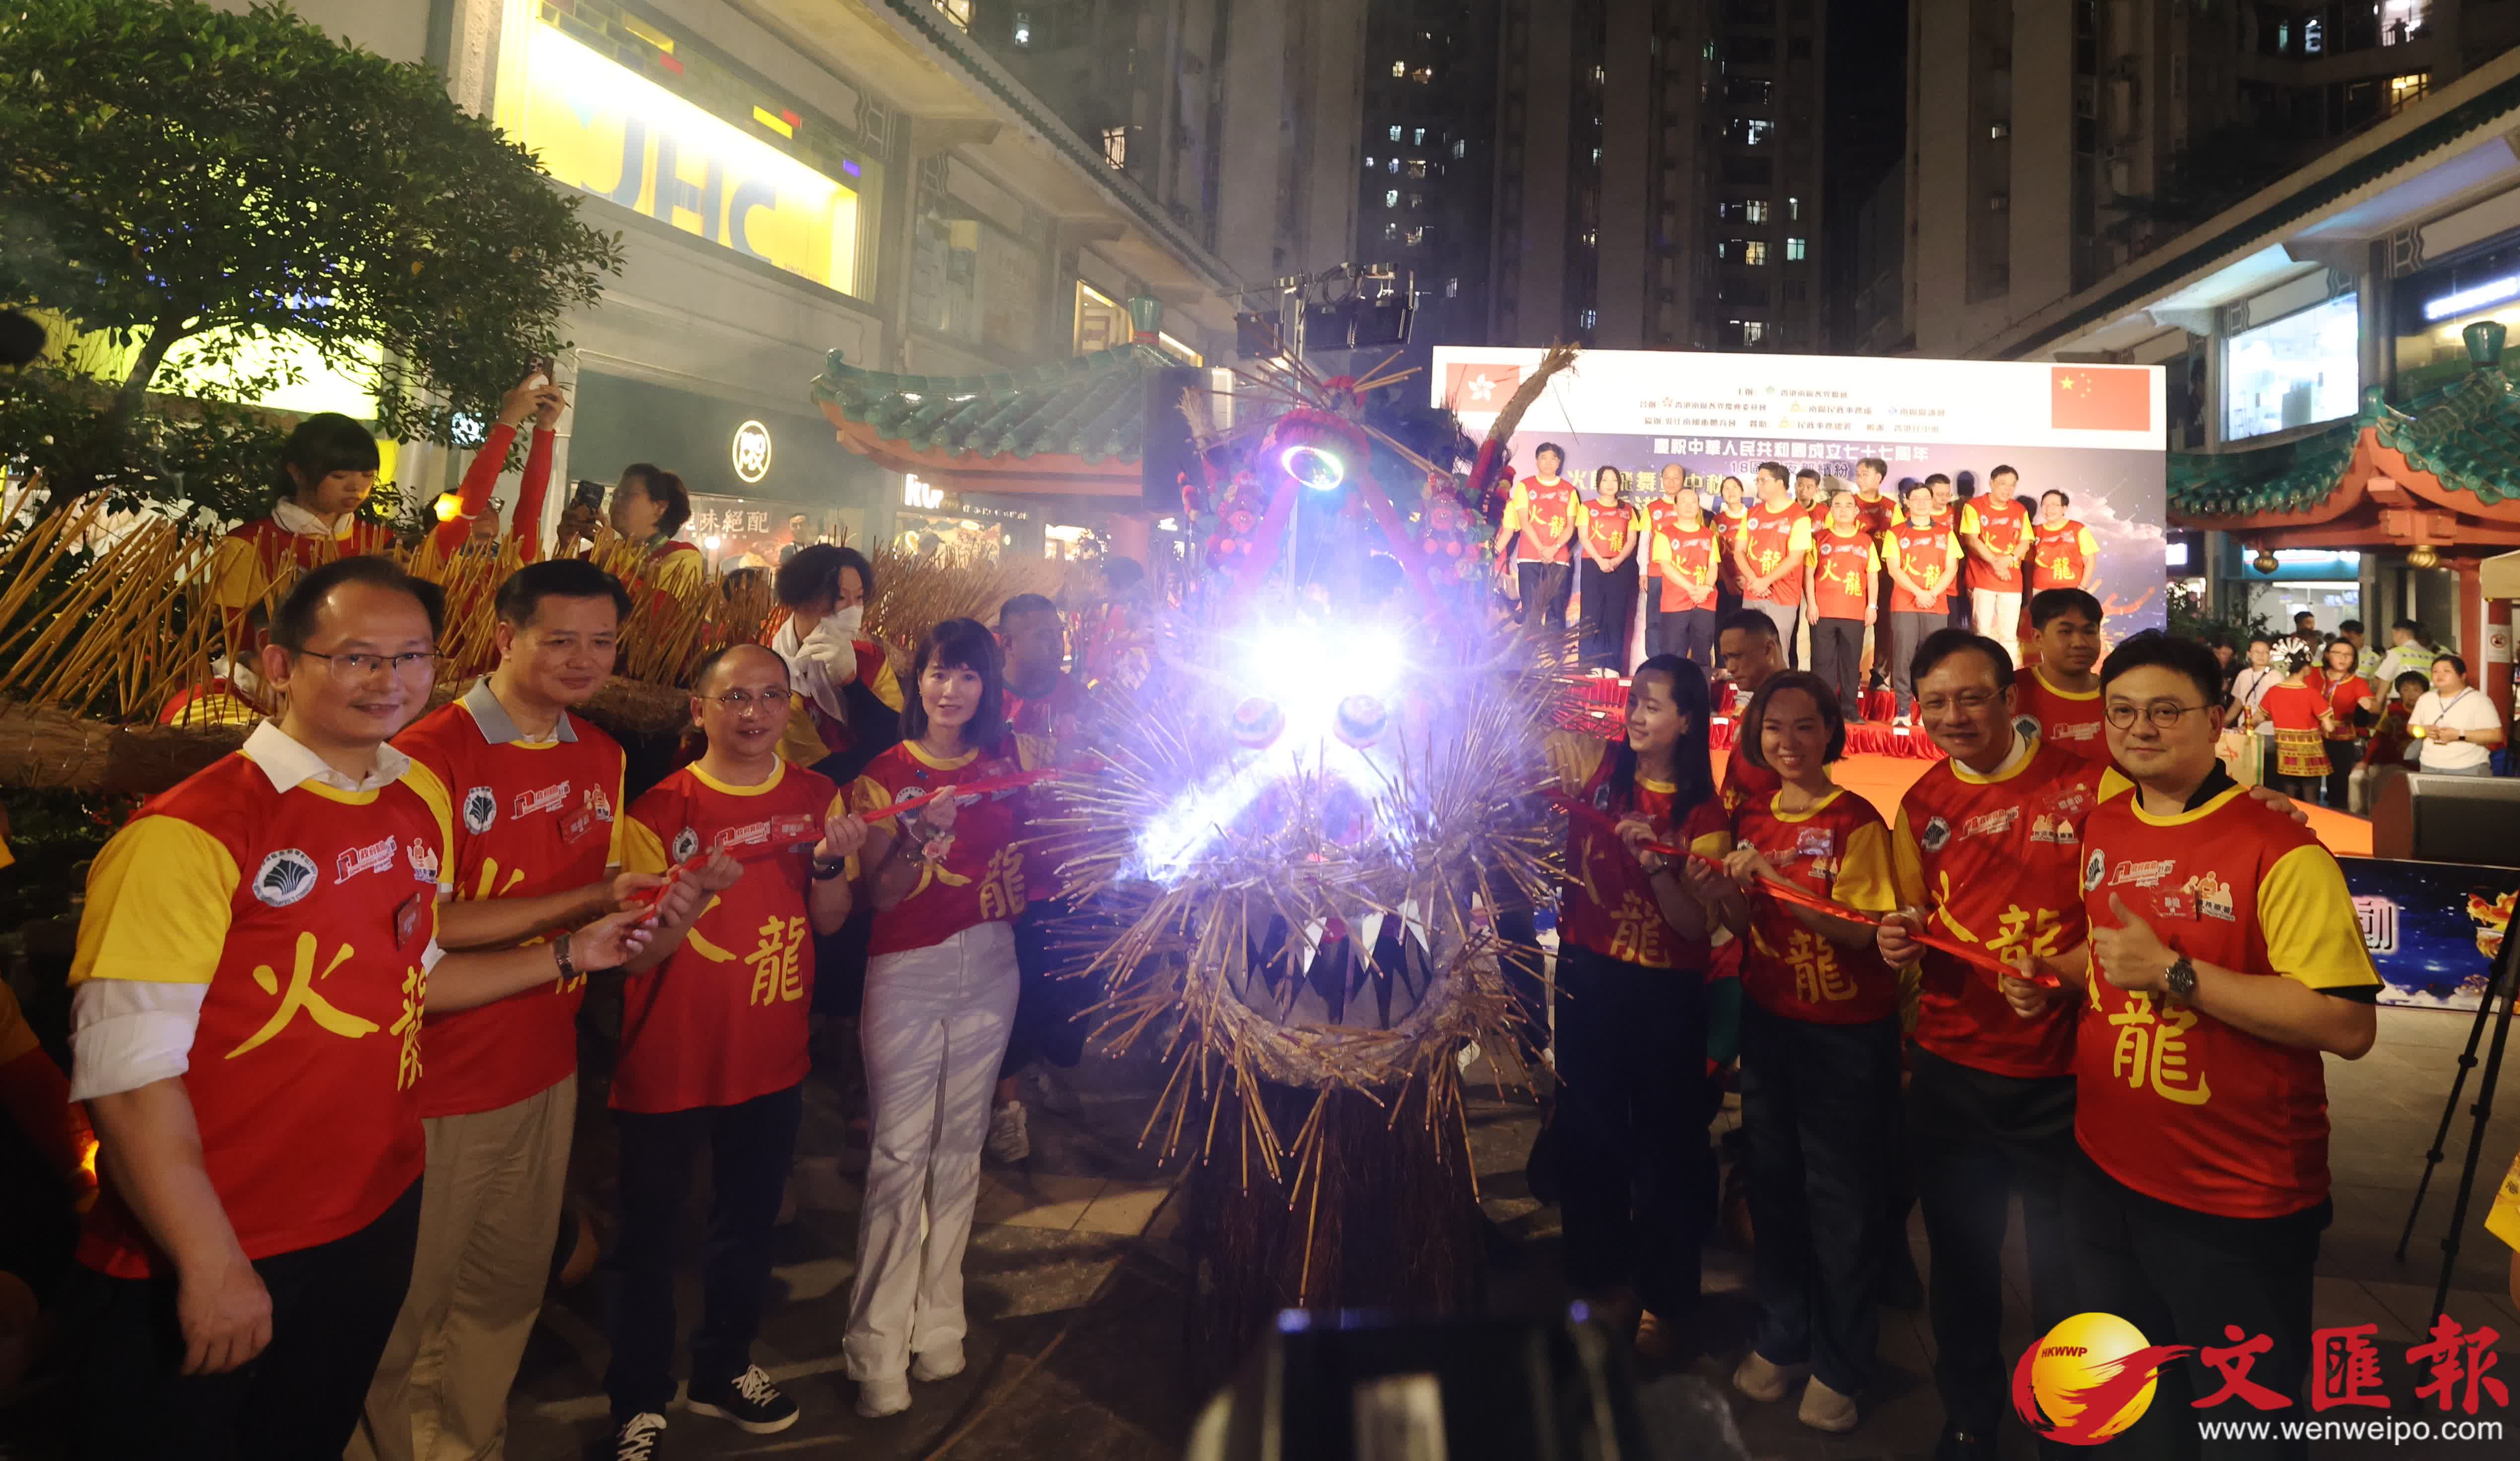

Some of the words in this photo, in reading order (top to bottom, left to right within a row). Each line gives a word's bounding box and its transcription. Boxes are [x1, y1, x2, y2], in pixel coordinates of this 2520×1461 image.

[1654, 438, 1930, 461] 慶祝中華人民共和國成立七十七周年
